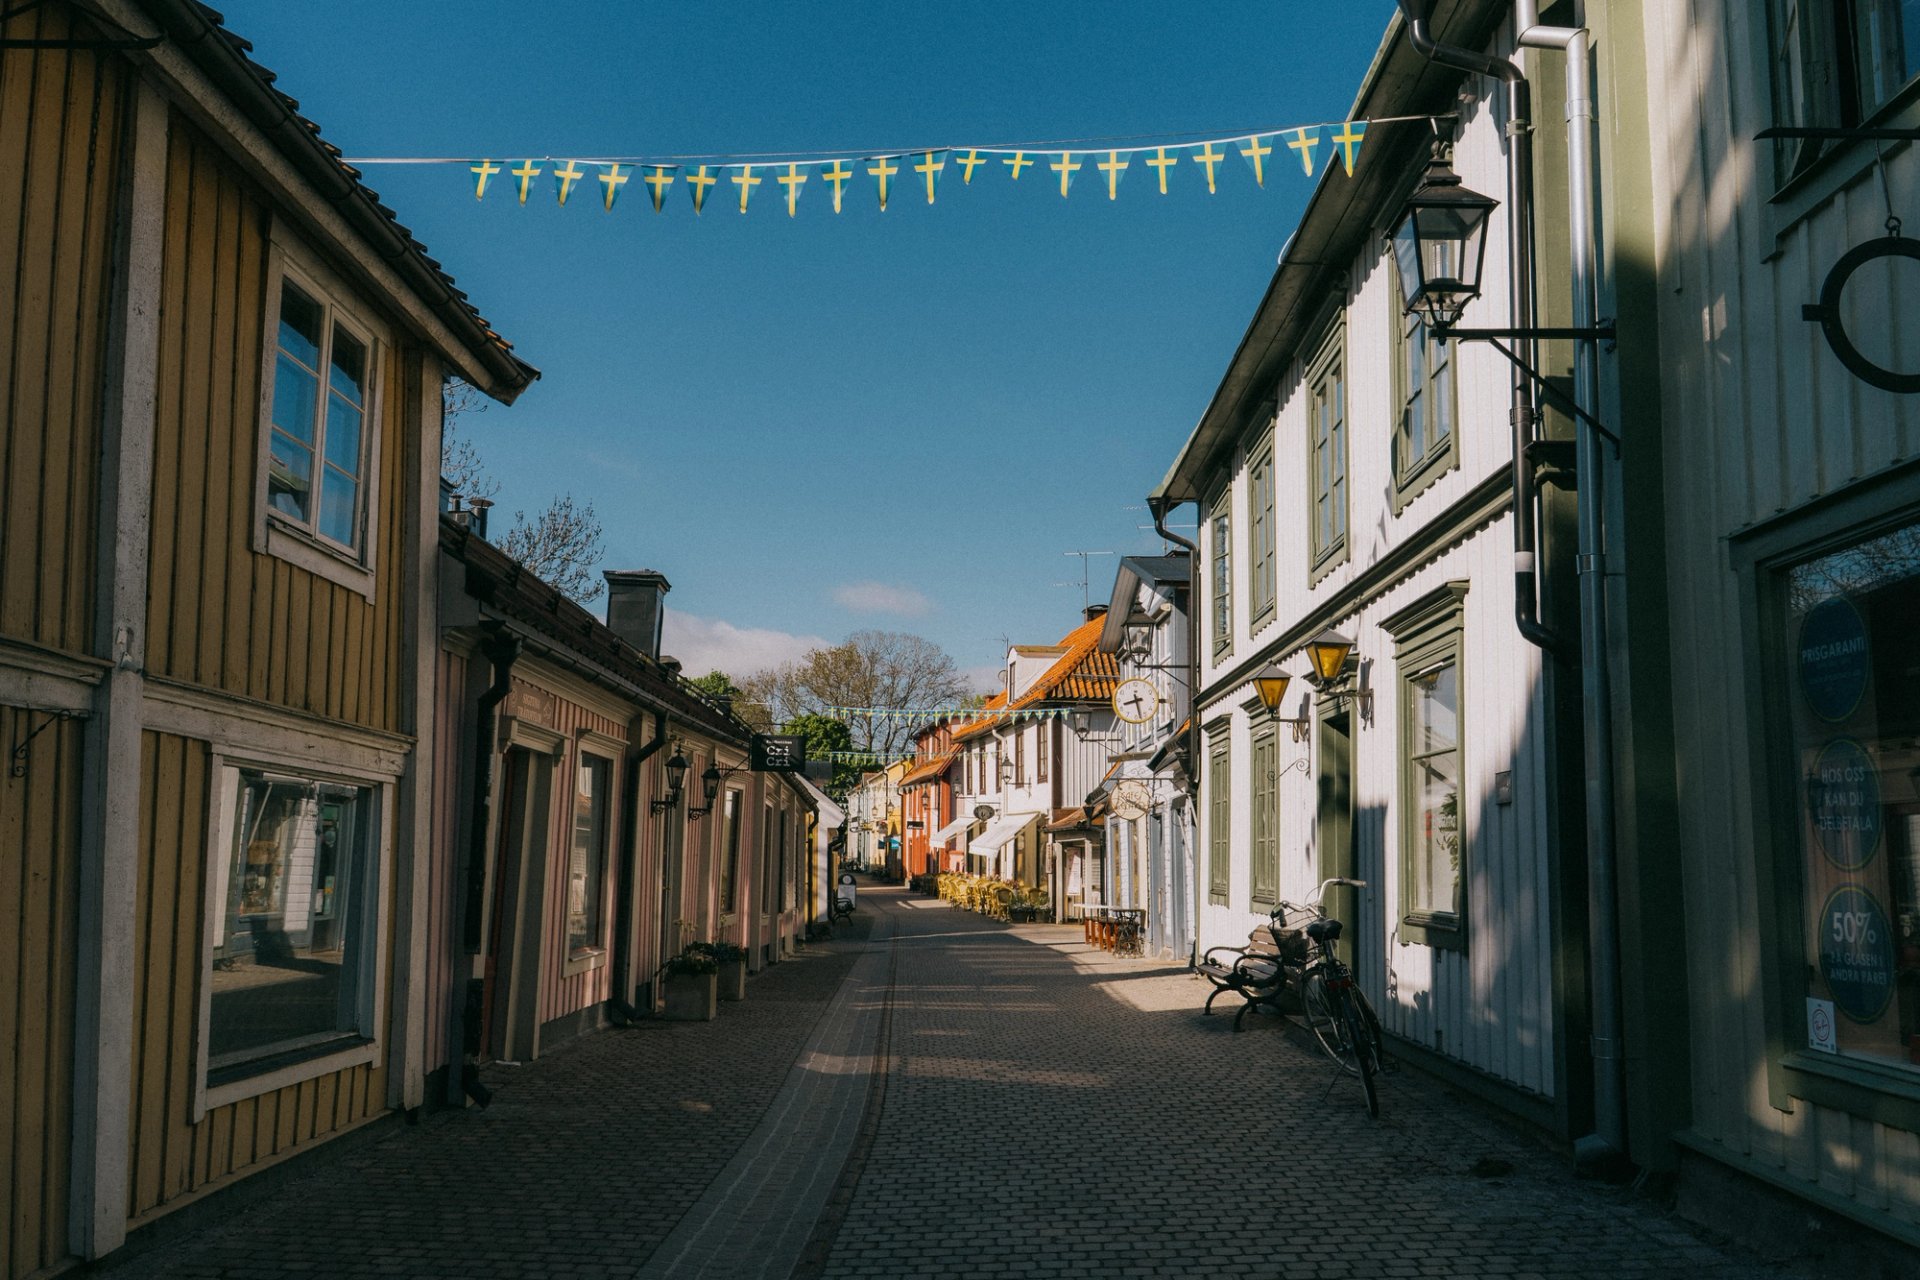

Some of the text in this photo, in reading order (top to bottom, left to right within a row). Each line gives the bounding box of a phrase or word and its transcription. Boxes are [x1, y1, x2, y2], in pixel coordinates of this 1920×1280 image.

[1801, 636, 1865, 664] PRISGARANTI
[766, 745, 791, 756] Cri
[766, 756, 791, 767] Cri
[1821, 766, 1865, 783] HOS OSS
[1824, 791, 1864, 807] KAN DU
[1818, 815, 1873, 831] DELBETALA
[1832, 911, 1876, 945] 50%
[1844, 952, 1878, 968] GLASEN
